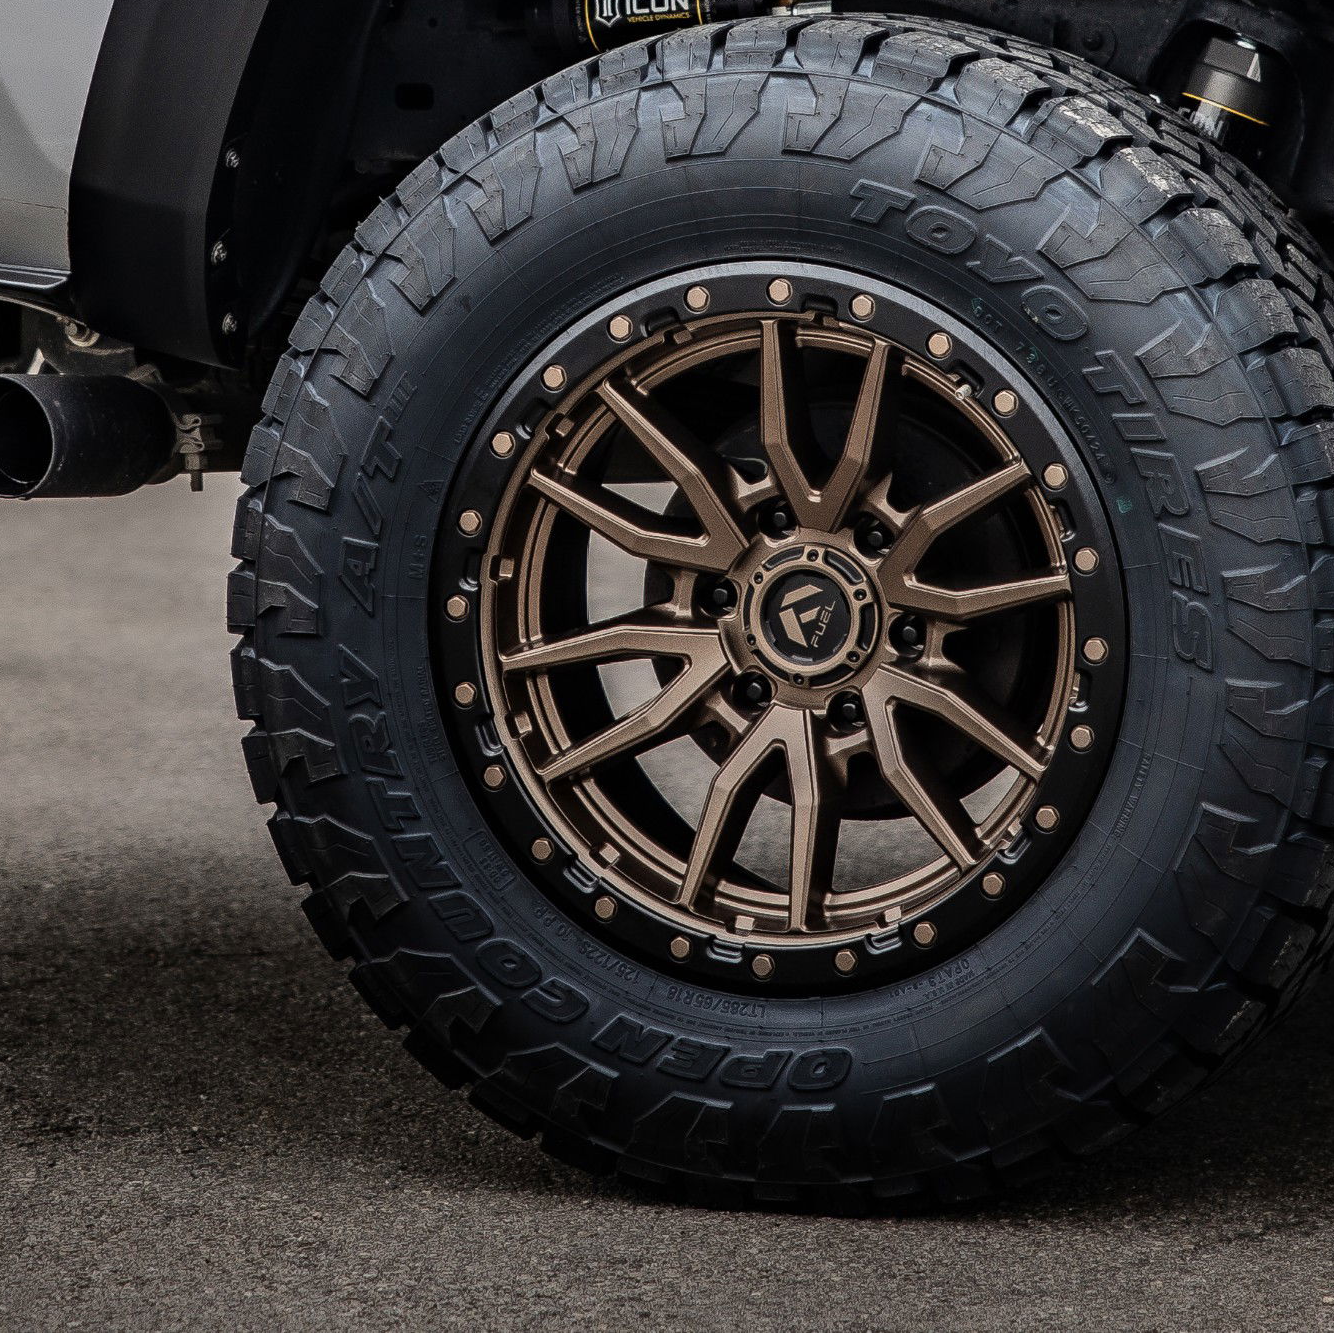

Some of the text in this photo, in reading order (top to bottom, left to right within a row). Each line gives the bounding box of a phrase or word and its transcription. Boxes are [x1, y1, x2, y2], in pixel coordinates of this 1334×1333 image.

[627, 11, 691, 24] VEHICLE DYNAMICS
[849, 179, 1214, 673] TOYO TIRES
[810, 601, 836, 648] FUEL
[339, 644, 590, 1024] COUNTRY
[590, 1014, 853, 1092] OPEN
